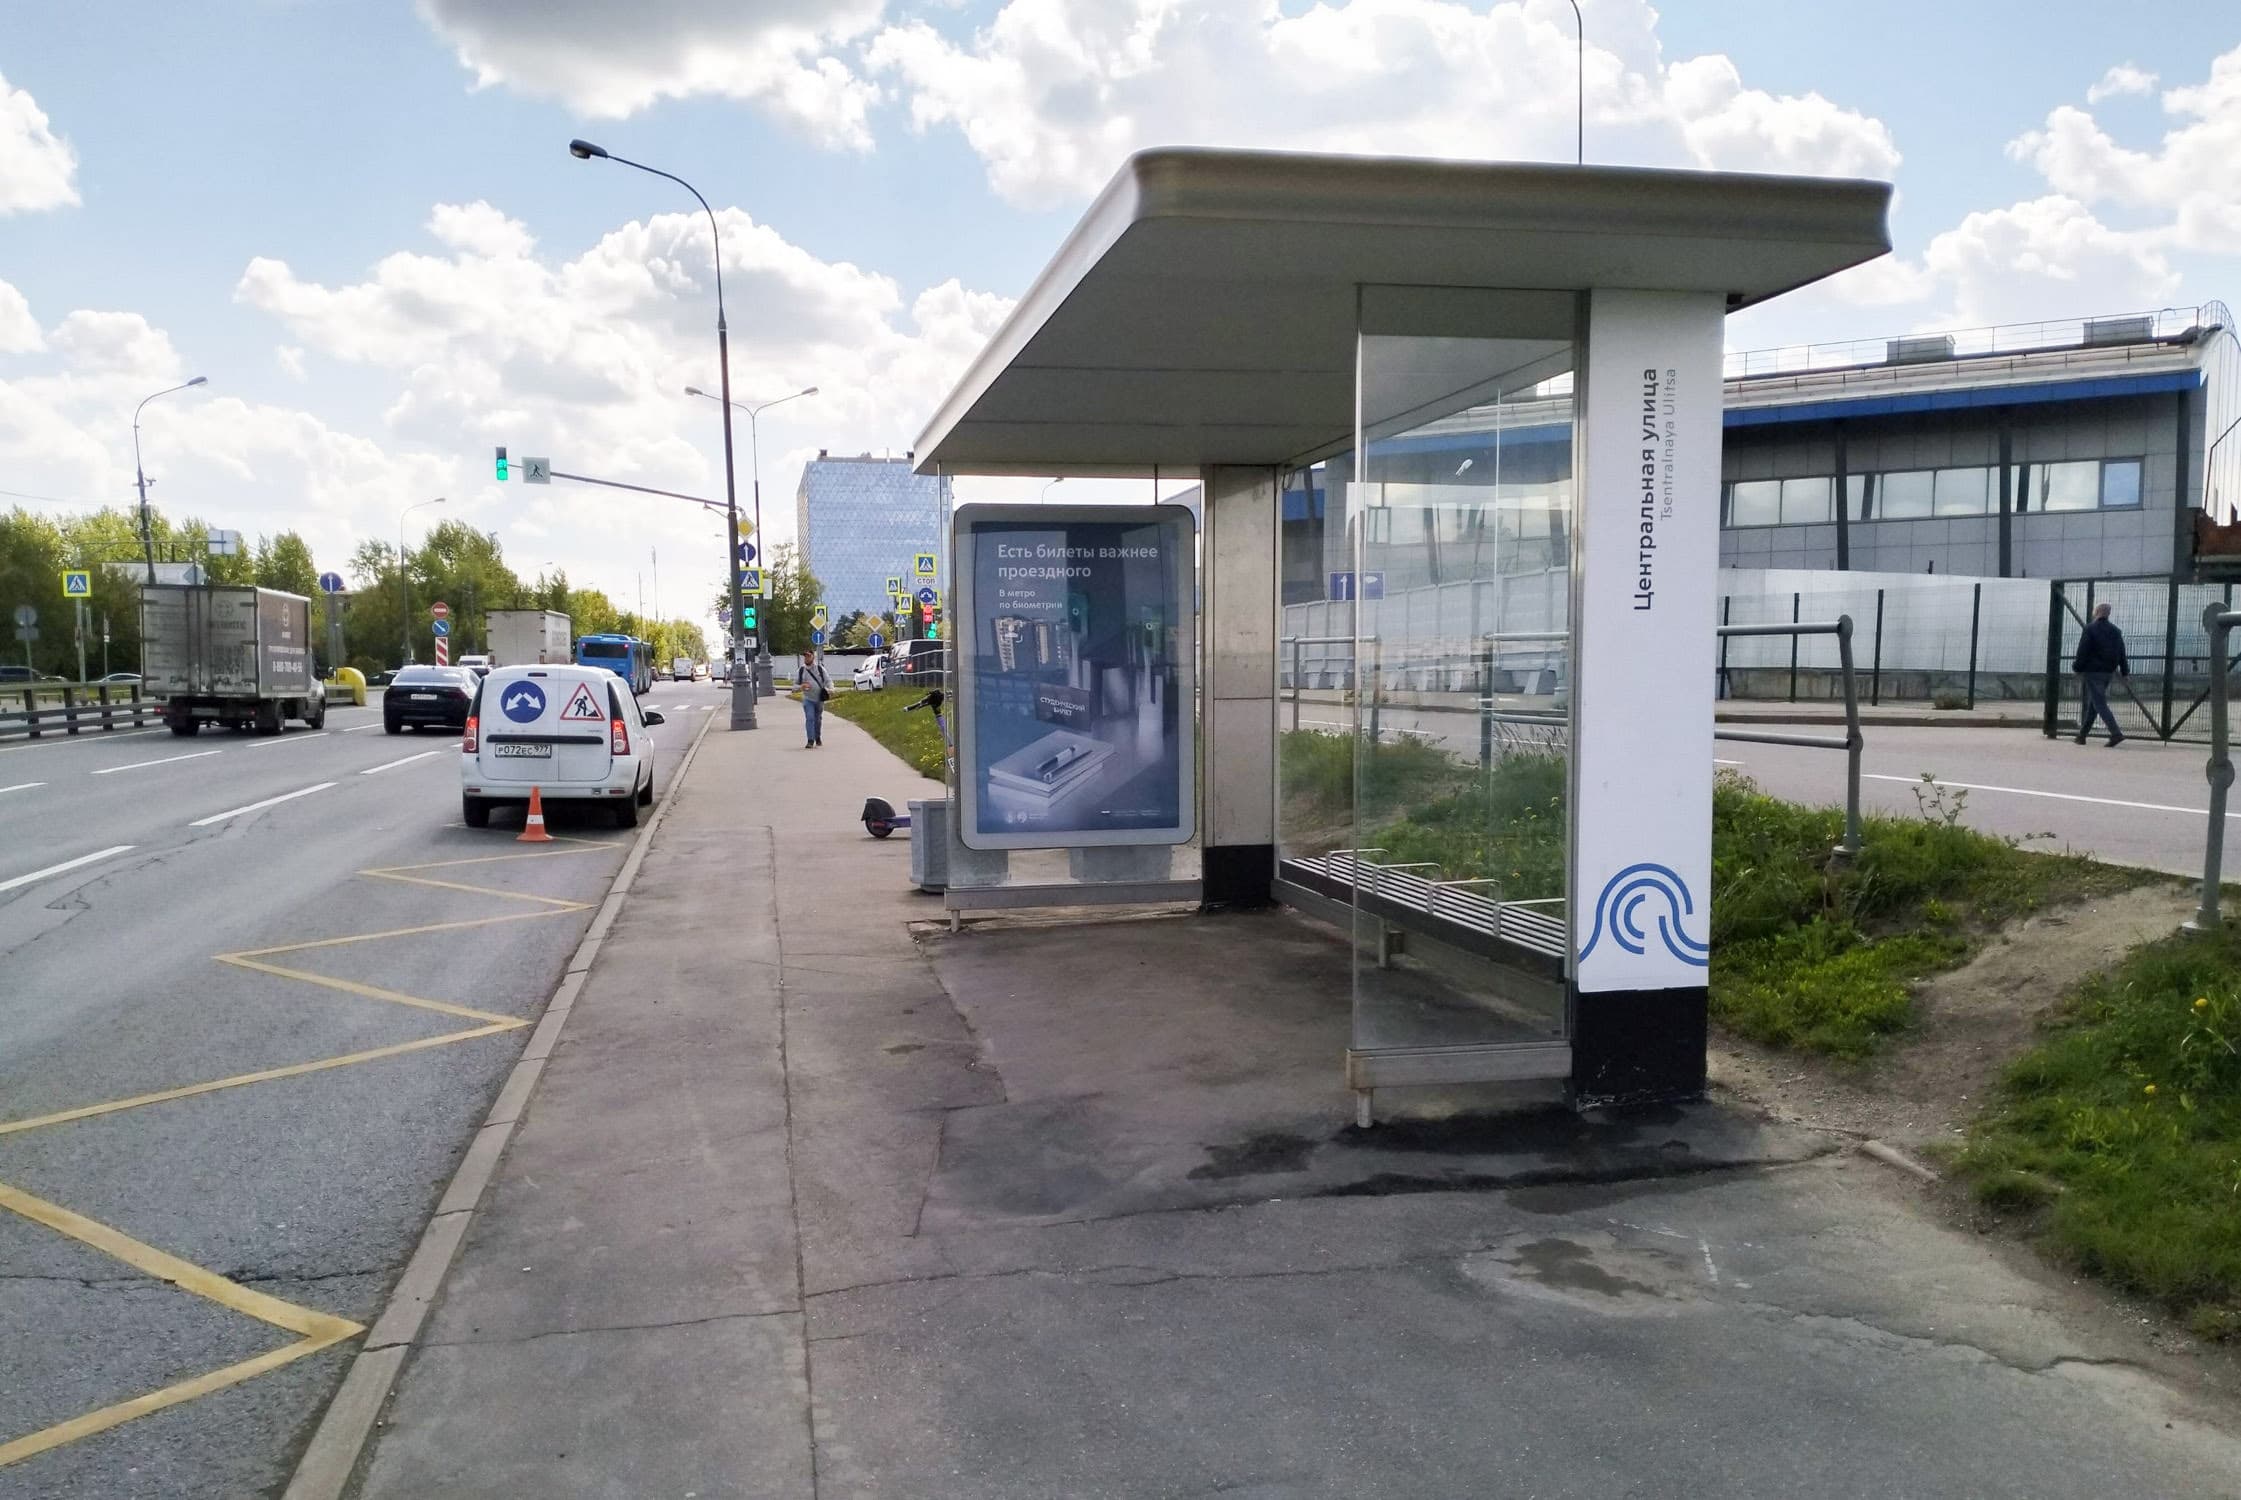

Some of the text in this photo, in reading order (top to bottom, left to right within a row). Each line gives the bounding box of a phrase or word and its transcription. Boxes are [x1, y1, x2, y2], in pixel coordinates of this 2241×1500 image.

[1661, 368, 1678, 521] Tsentralnaya Ulitsa
[1634, 368, 1660, 611] Центральная улица
[998, 544, 1159, 558] Есть билеты важнее
[998, 566, 1092, 580] проездного
[999, 589, 1036, 599] В метро
[1012, 600, 1063, 610] биометрии
